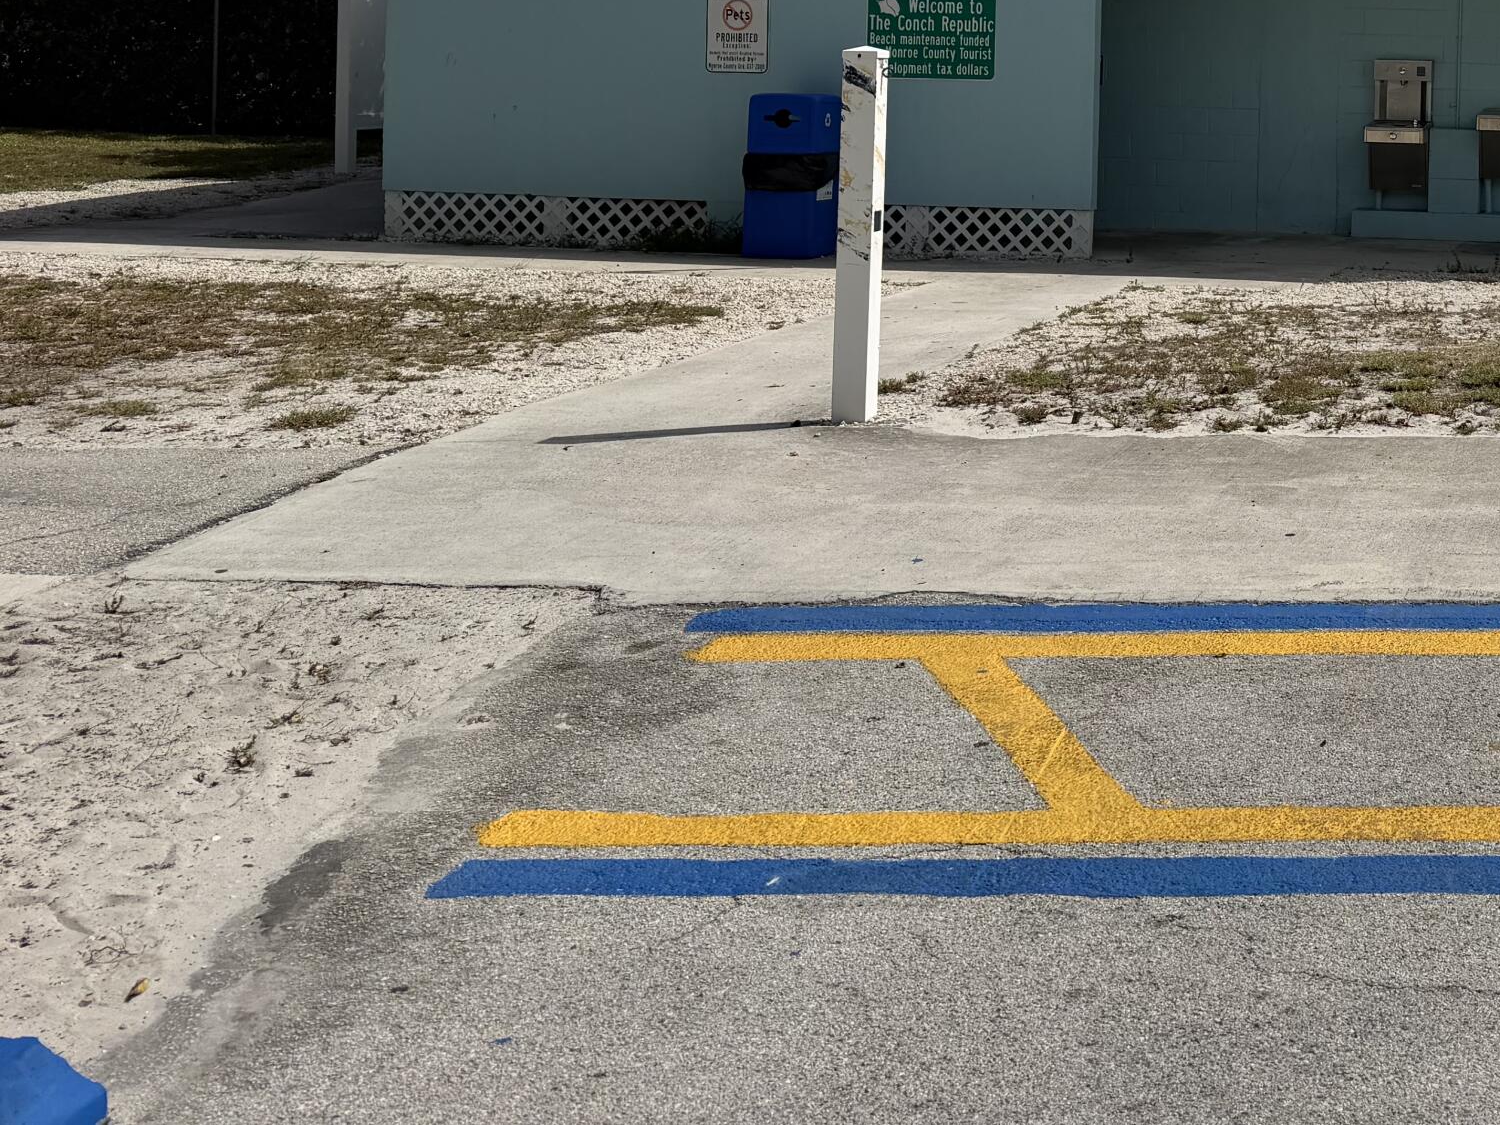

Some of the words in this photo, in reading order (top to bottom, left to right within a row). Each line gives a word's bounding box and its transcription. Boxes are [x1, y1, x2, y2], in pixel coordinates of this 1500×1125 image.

[726, 8, 750, 21] Pets
[970, 0, 983, 14] to
[869, 14, 890, 31] The
[898, 15, 934, 32] Conch
[942, 16, 994, 35] Republic
[716, 32, 758, 43] PROHIBITED
[869, 32, 895, 45] Beach
[900, 34, 955, 46] maintenance
[960, 34, 990, 47] funded
[923, 47, 955, 62] County
[960, 47, 991, 60] Tourist
[889, 62, 932, 77] elopment
[937, 63, 952, 75] tax
[957, 64, 989, 76] dollars
